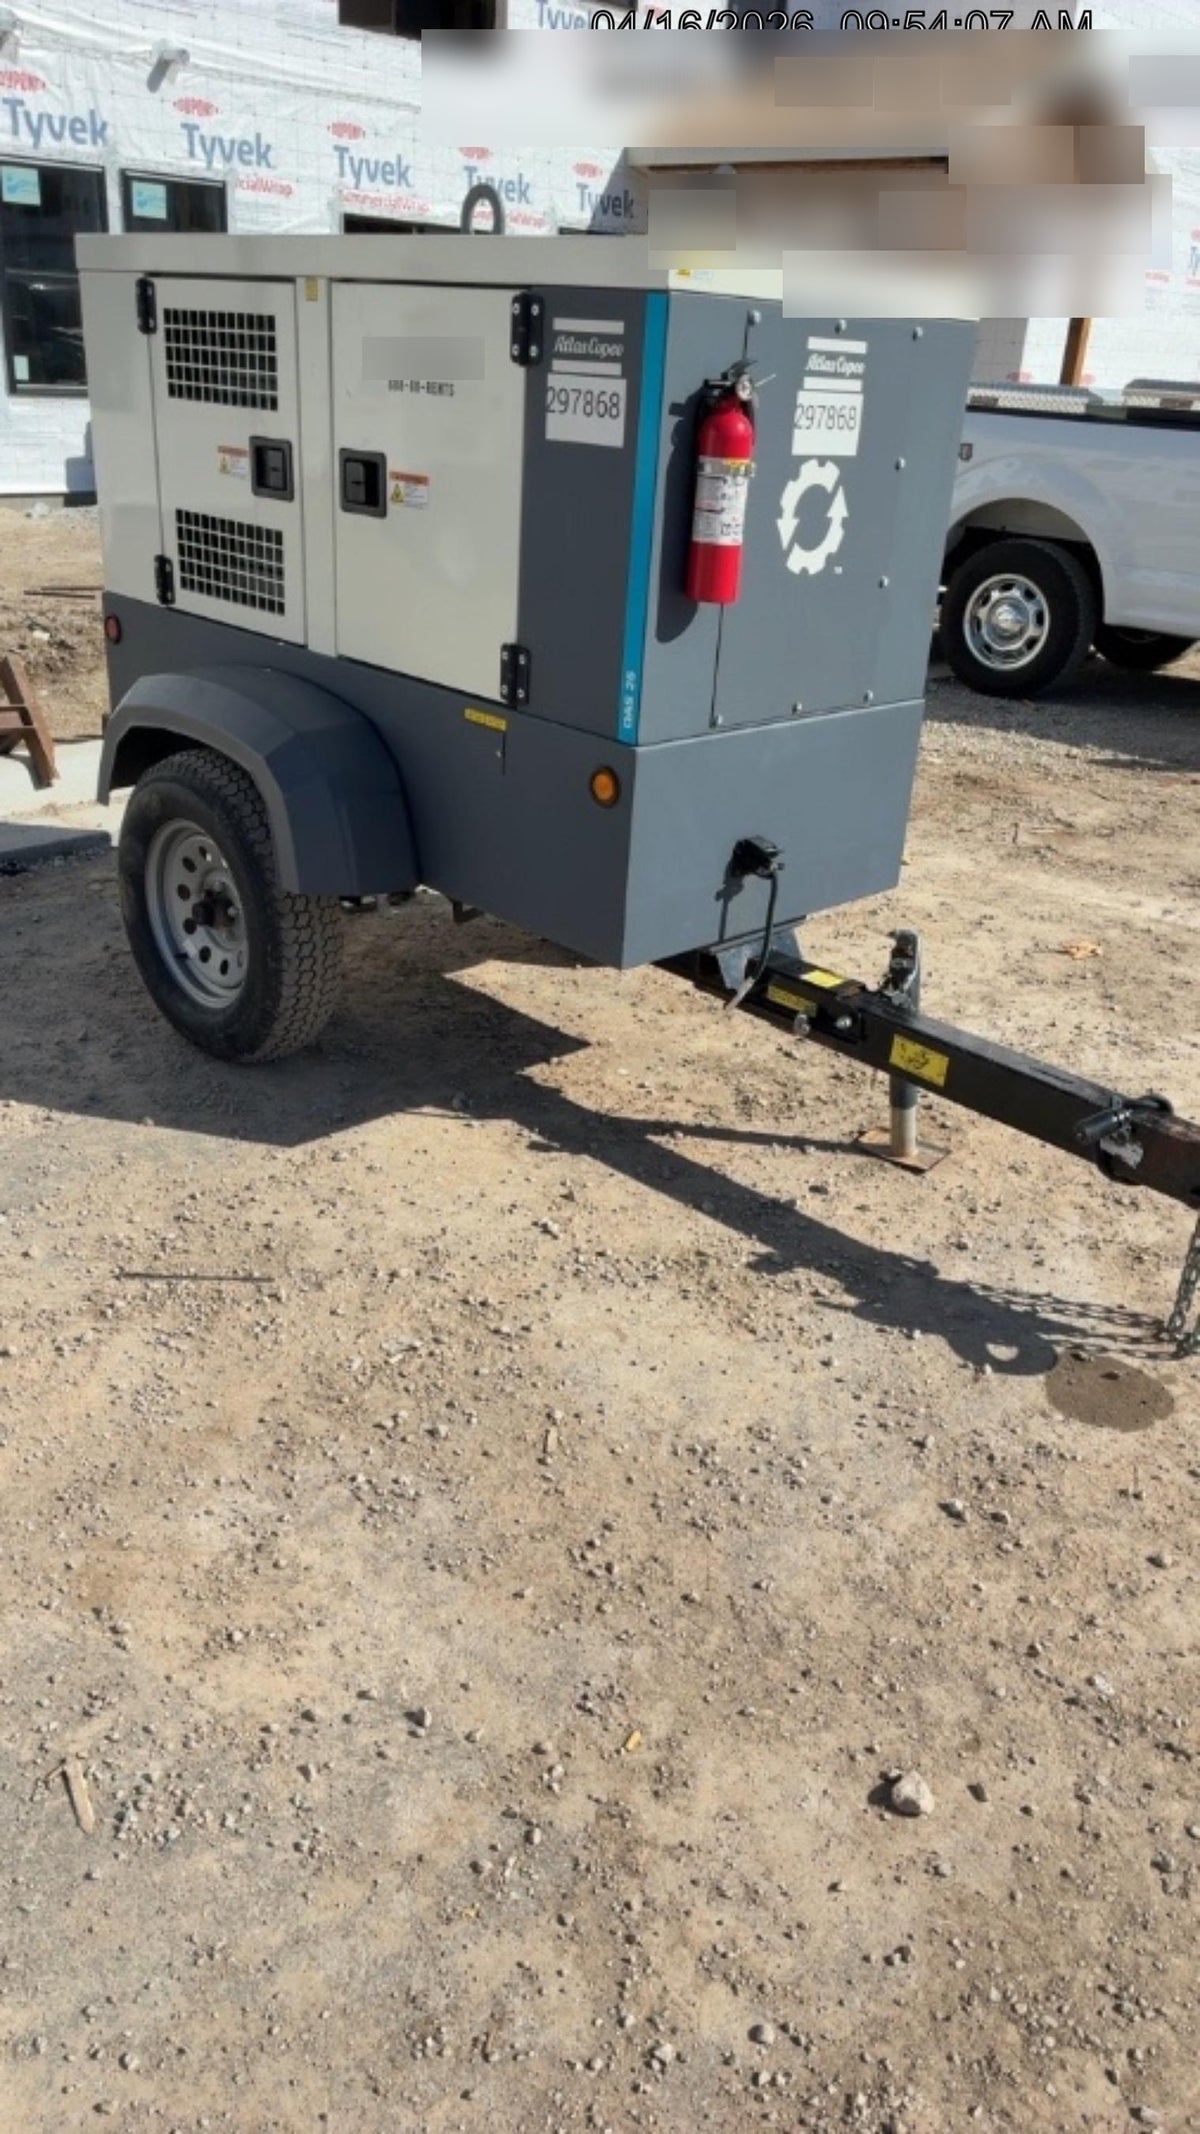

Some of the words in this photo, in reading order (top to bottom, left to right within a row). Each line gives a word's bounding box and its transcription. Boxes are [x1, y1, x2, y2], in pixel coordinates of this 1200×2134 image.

[2, 97, 108, 149] Tyvek
[180, 122, 272, 170] Tyvek
[333, 144, 412, 189] Tyvek
[576, 183, 634, 221] Tyvek
[546, 385, 620, 420] 297868
[794, 403, 857, 431] 297868
